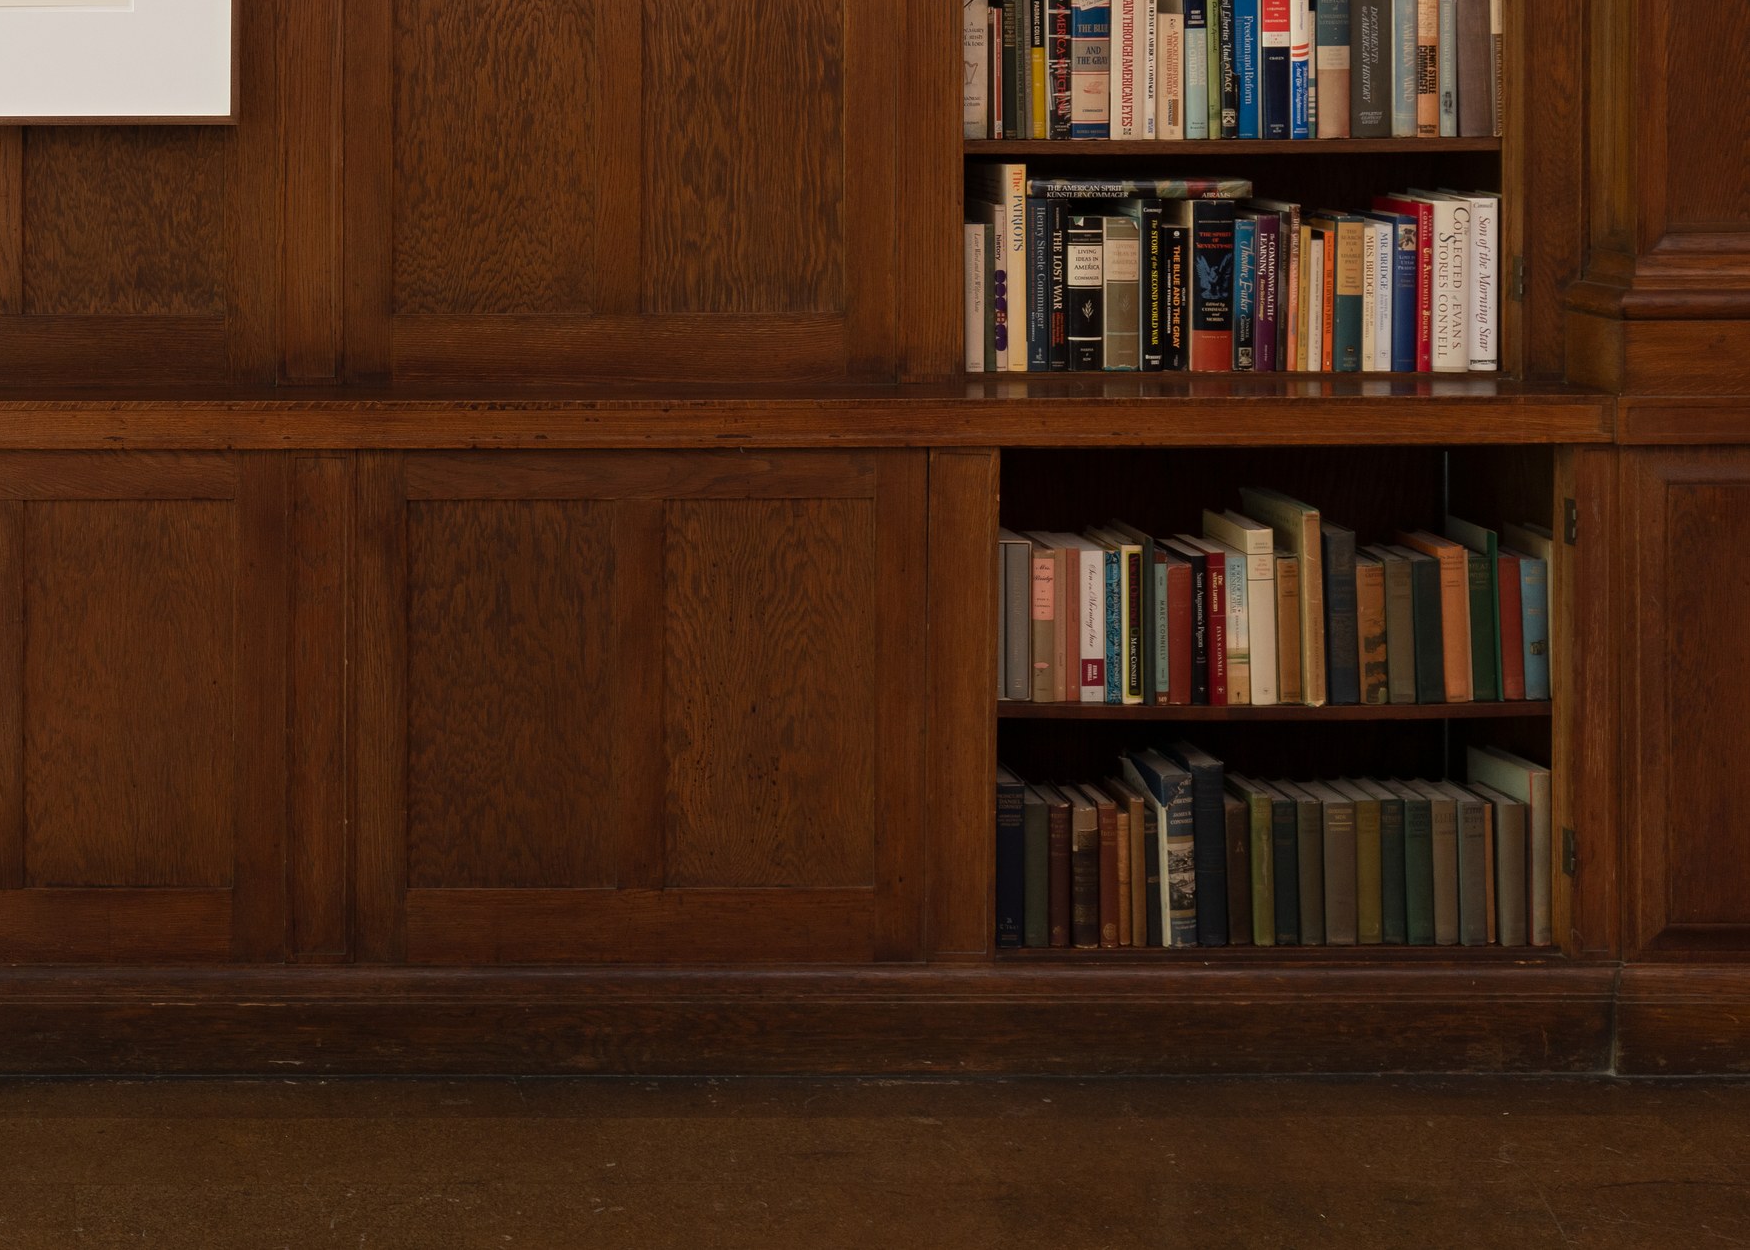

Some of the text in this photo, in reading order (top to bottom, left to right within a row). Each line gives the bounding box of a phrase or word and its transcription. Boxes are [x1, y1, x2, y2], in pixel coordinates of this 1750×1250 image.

[1123, 16, 1133, 57] THROUGH
[1244, 16, 1253, 104] Freedom and Reform
[1362, 14, 1370, 63] AMERICAN
[1370, 6, 1379, 64] DOCUMENTS
[1122, 58, 1133, 103] AMERICAN
[1362, 65, 1370, 102] HISTORY
[1419, 46, 1427, 94] COMMAGER
[1122, 105, 1132, 127] EYES
[1012, 169, 1023, 252] The PATRIOTS
[1034, 207, 1046, 328] Henry Steele Commager
[1052, 231, 1062, 309] THE LOST WAR
[1366, 235, 1374, 298] MRS. BRIDGE
[1380, 232, 1389, 290] MR. BRIDGE
[1453, 208, 1470, 288] COLLECTED
[1151, 270, 1159, 300] SECOND
[1438, 232, 1456, 358] STORIES CONNELL
[1476, 216, 1492, 351] Son of the Morning Star
[1453, 303, 1462, 340] EVAN
